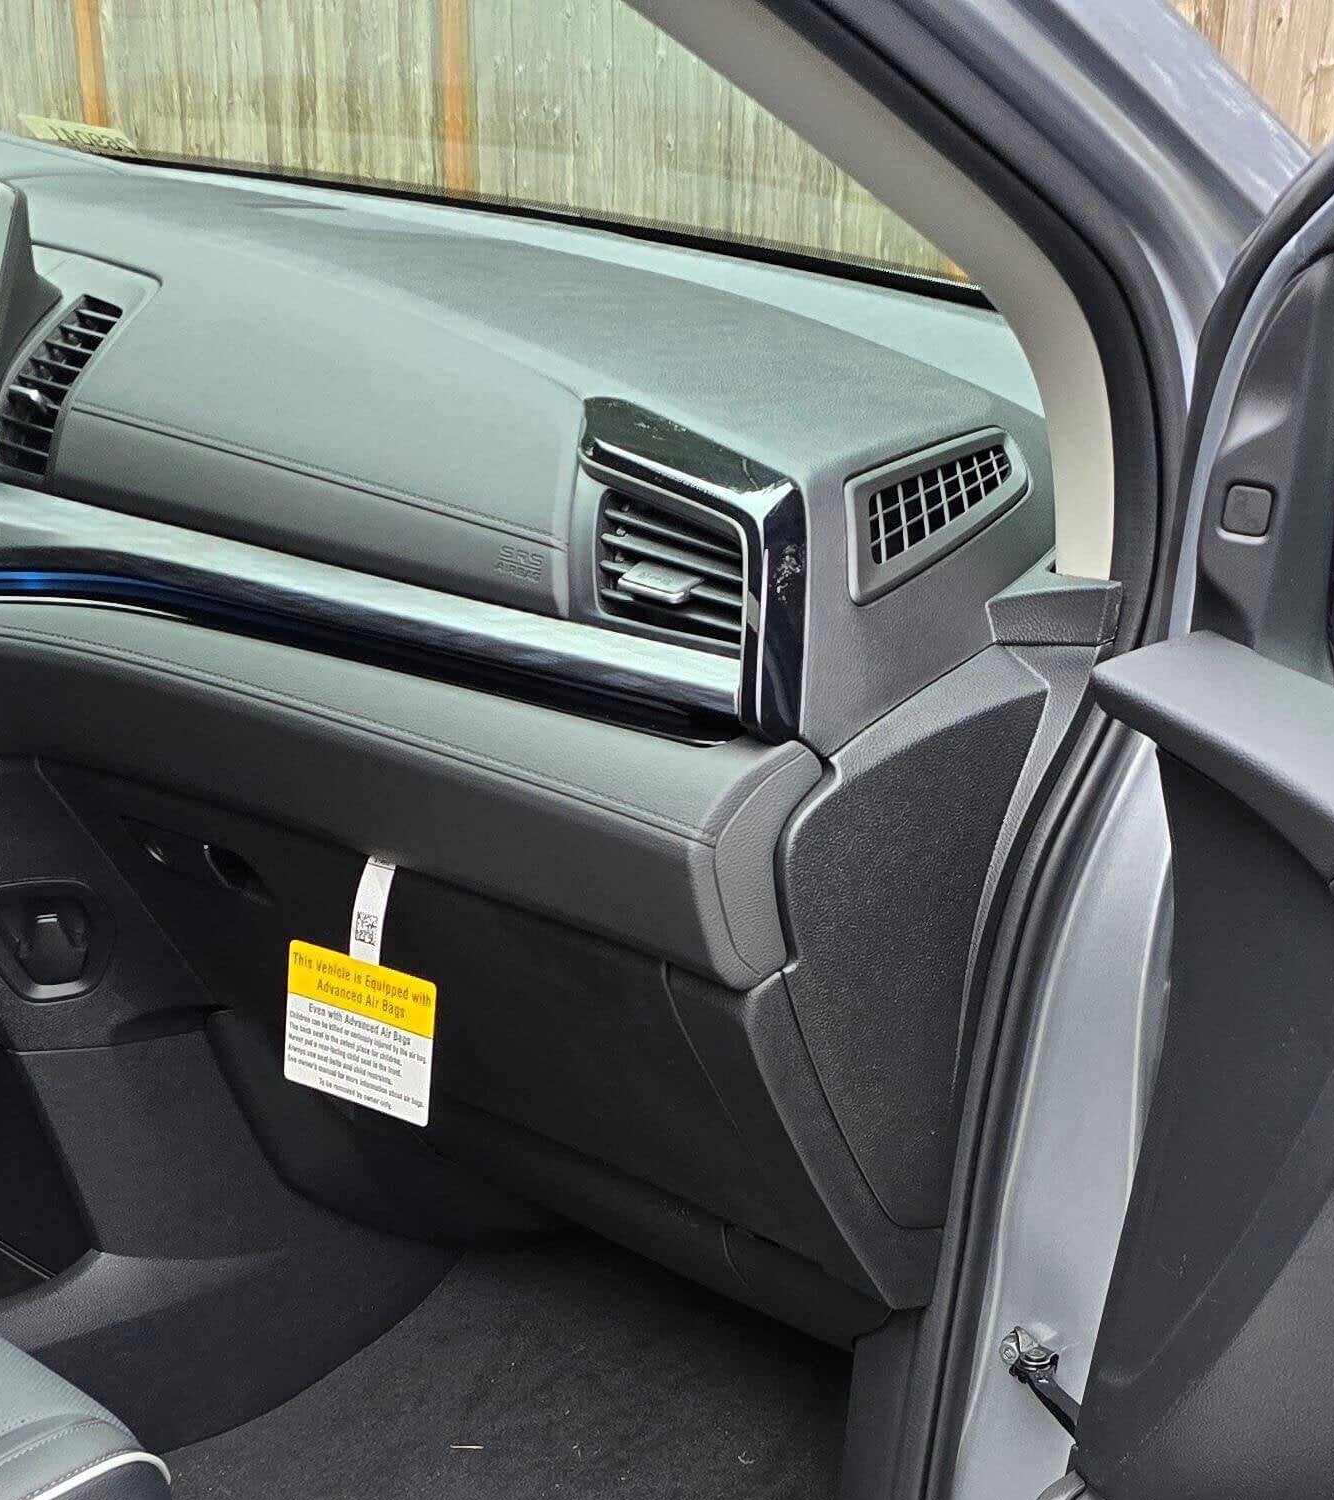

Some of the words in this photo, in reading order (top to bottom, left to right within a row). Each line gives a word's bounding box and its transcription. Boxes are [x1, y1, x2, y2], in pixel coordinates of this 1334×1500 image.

[495, 561, 542, 582] AIRBAG
[498, 545, 545, 567] SRS
[292, 952, 312, 968] This
[315, 959, 350, 980] Vehicle
[353, 970, 362, 985] is
[365, 975, 408, 1000] Equipped
[411, 990, 431, 1006] with
[316, 979, 362, 1003] Advanced
[364, 993, 379, 1009] Air
[382, 1000, 405, 1019] Bags
[308, 1003, 325, 1015] Even
[327, 1010, 342, 1021] with
[343, 1015, 378, 1033] Advanced
[380, 1026, 391, 1039] Air
[392, 1031, 411, 1046] Bags
